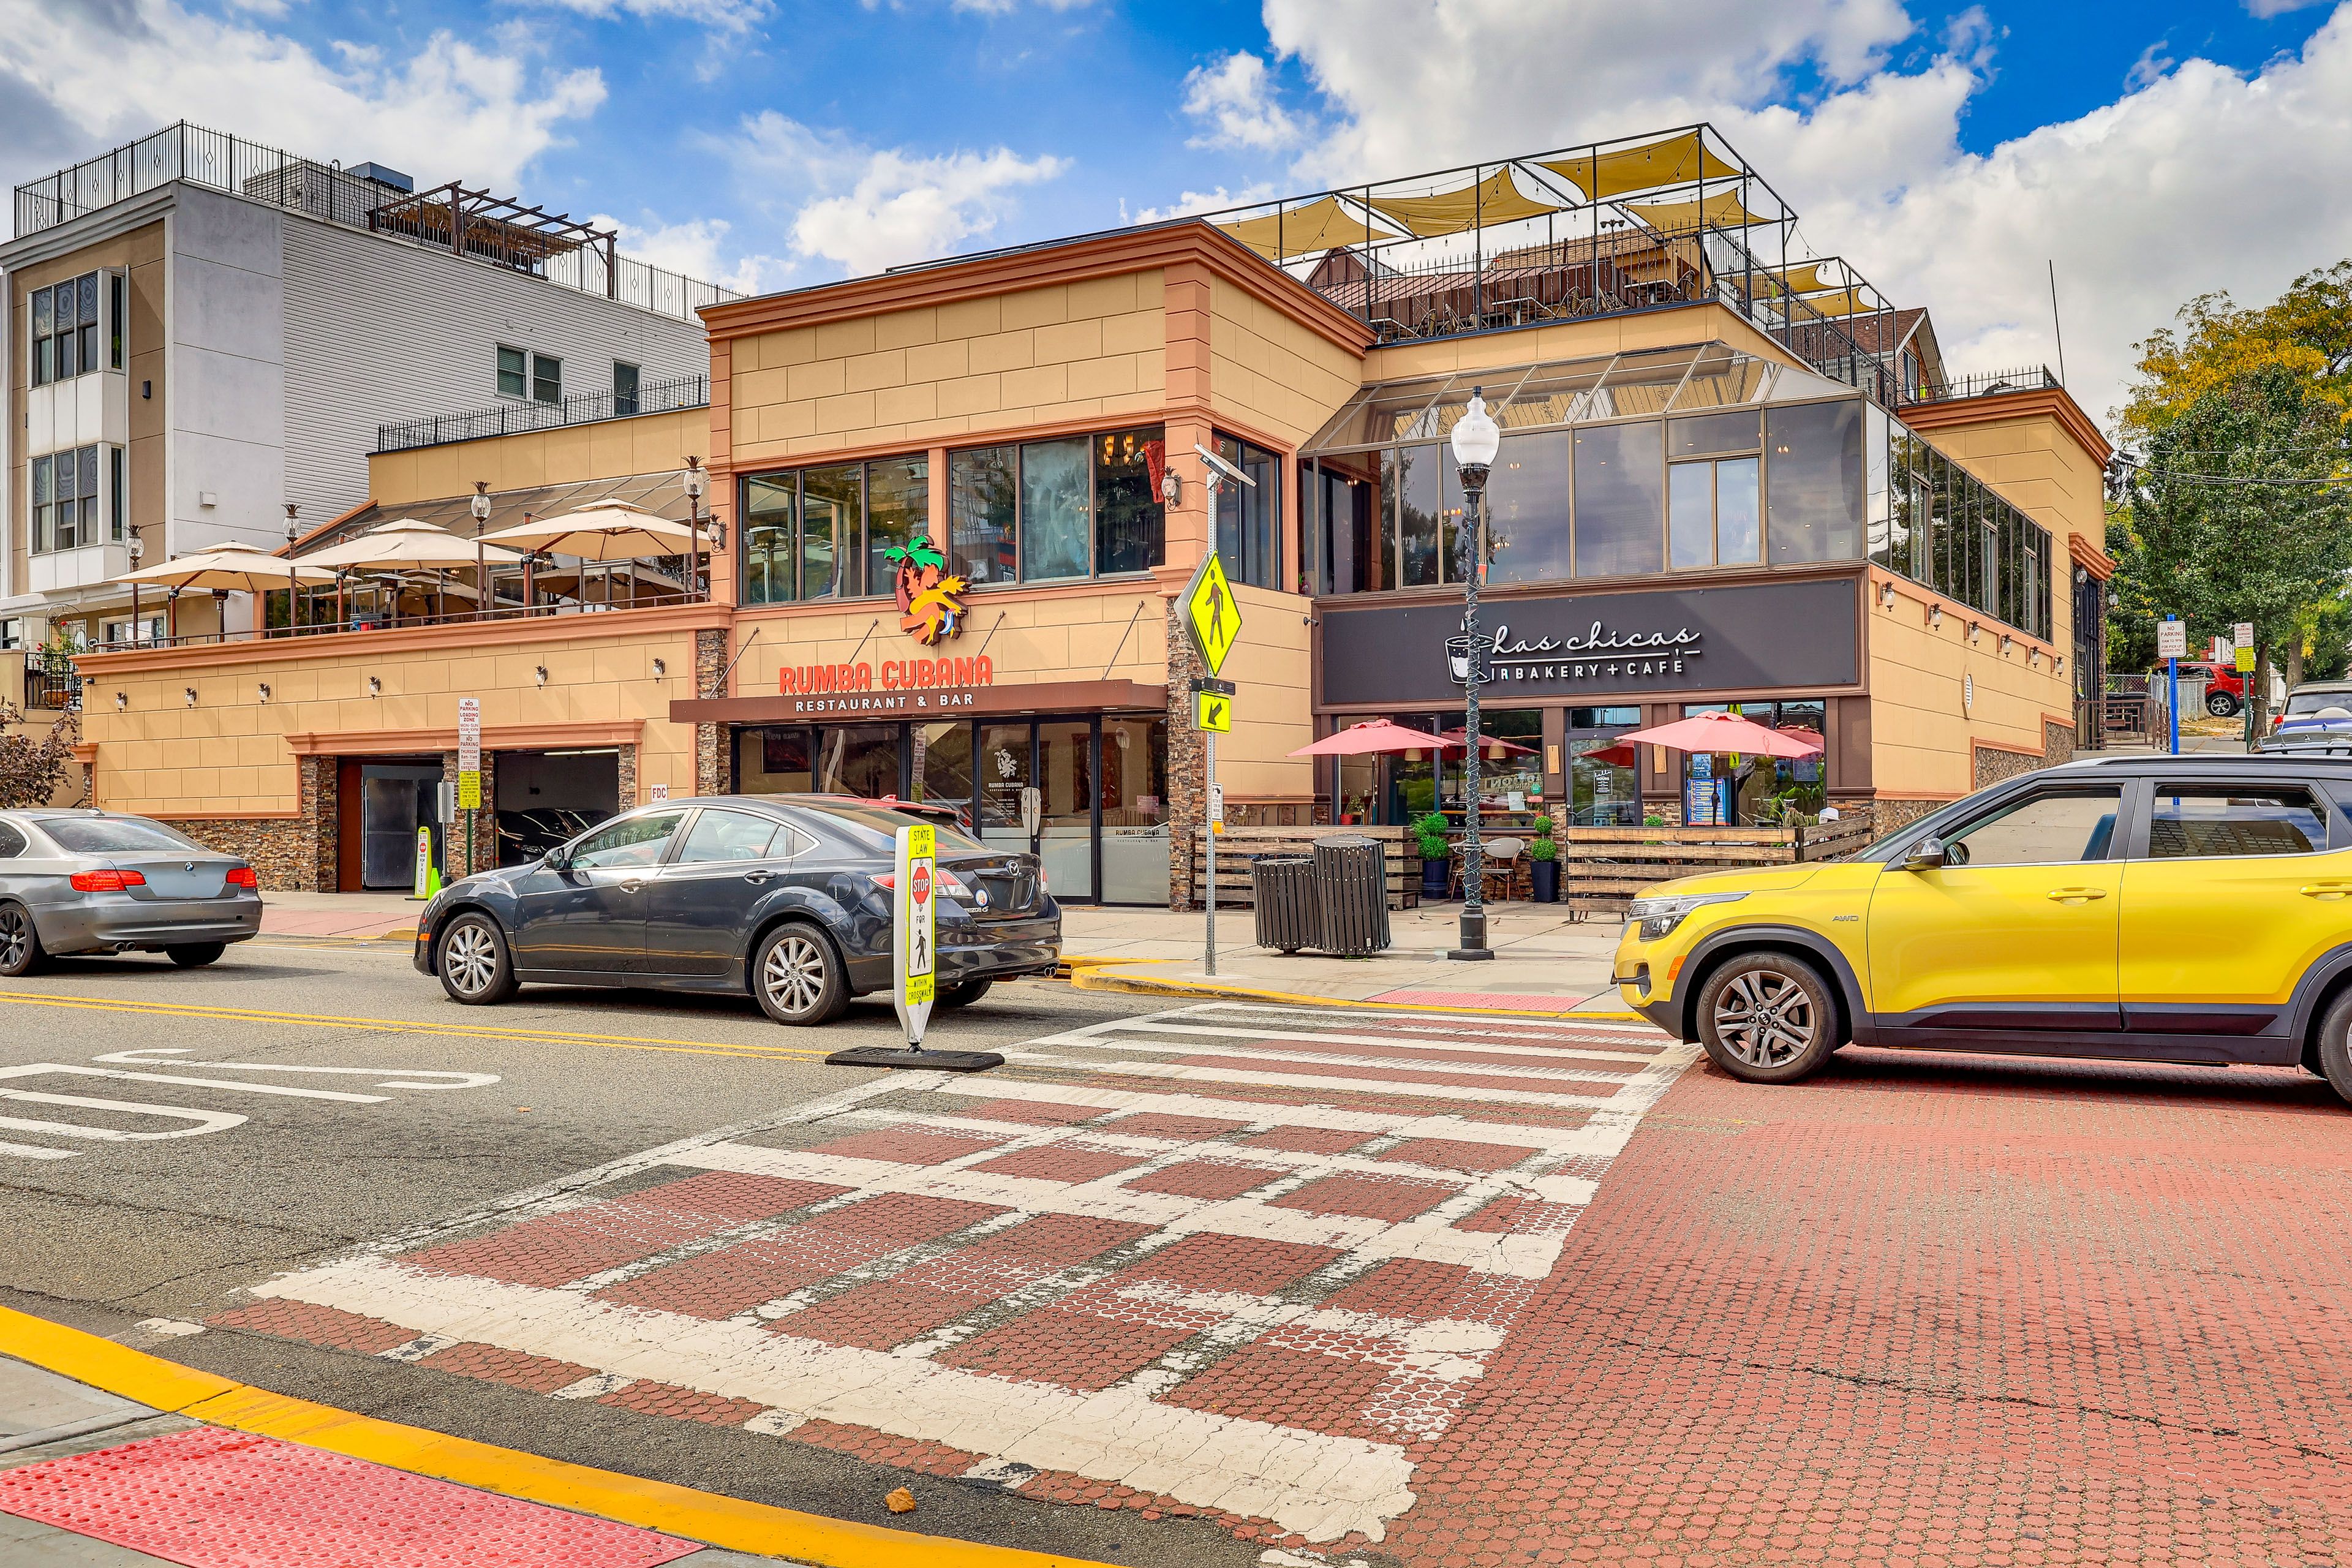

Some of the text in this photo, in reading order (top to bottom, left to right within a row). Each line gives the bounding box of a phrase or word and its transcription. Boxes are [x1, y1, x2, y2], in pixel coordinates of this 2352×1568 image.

[1566, 620, 1701, 650] chicas
[780, 655, 993, 694] RUMBA CUBANA
[796, 693, 974, 712] RESTAURANT & BAR
[652, 787, 666, 799] FDC
[913, 830, 930, 842] STATE
[916, 843, 928, 855] LAW
[913, 878, 929, 893] STOP
[916, 915, 925, 924] FOR
[914, 978, 927, 988] WITHIN
[908, 988, 932, 1001] CROSSWALK
